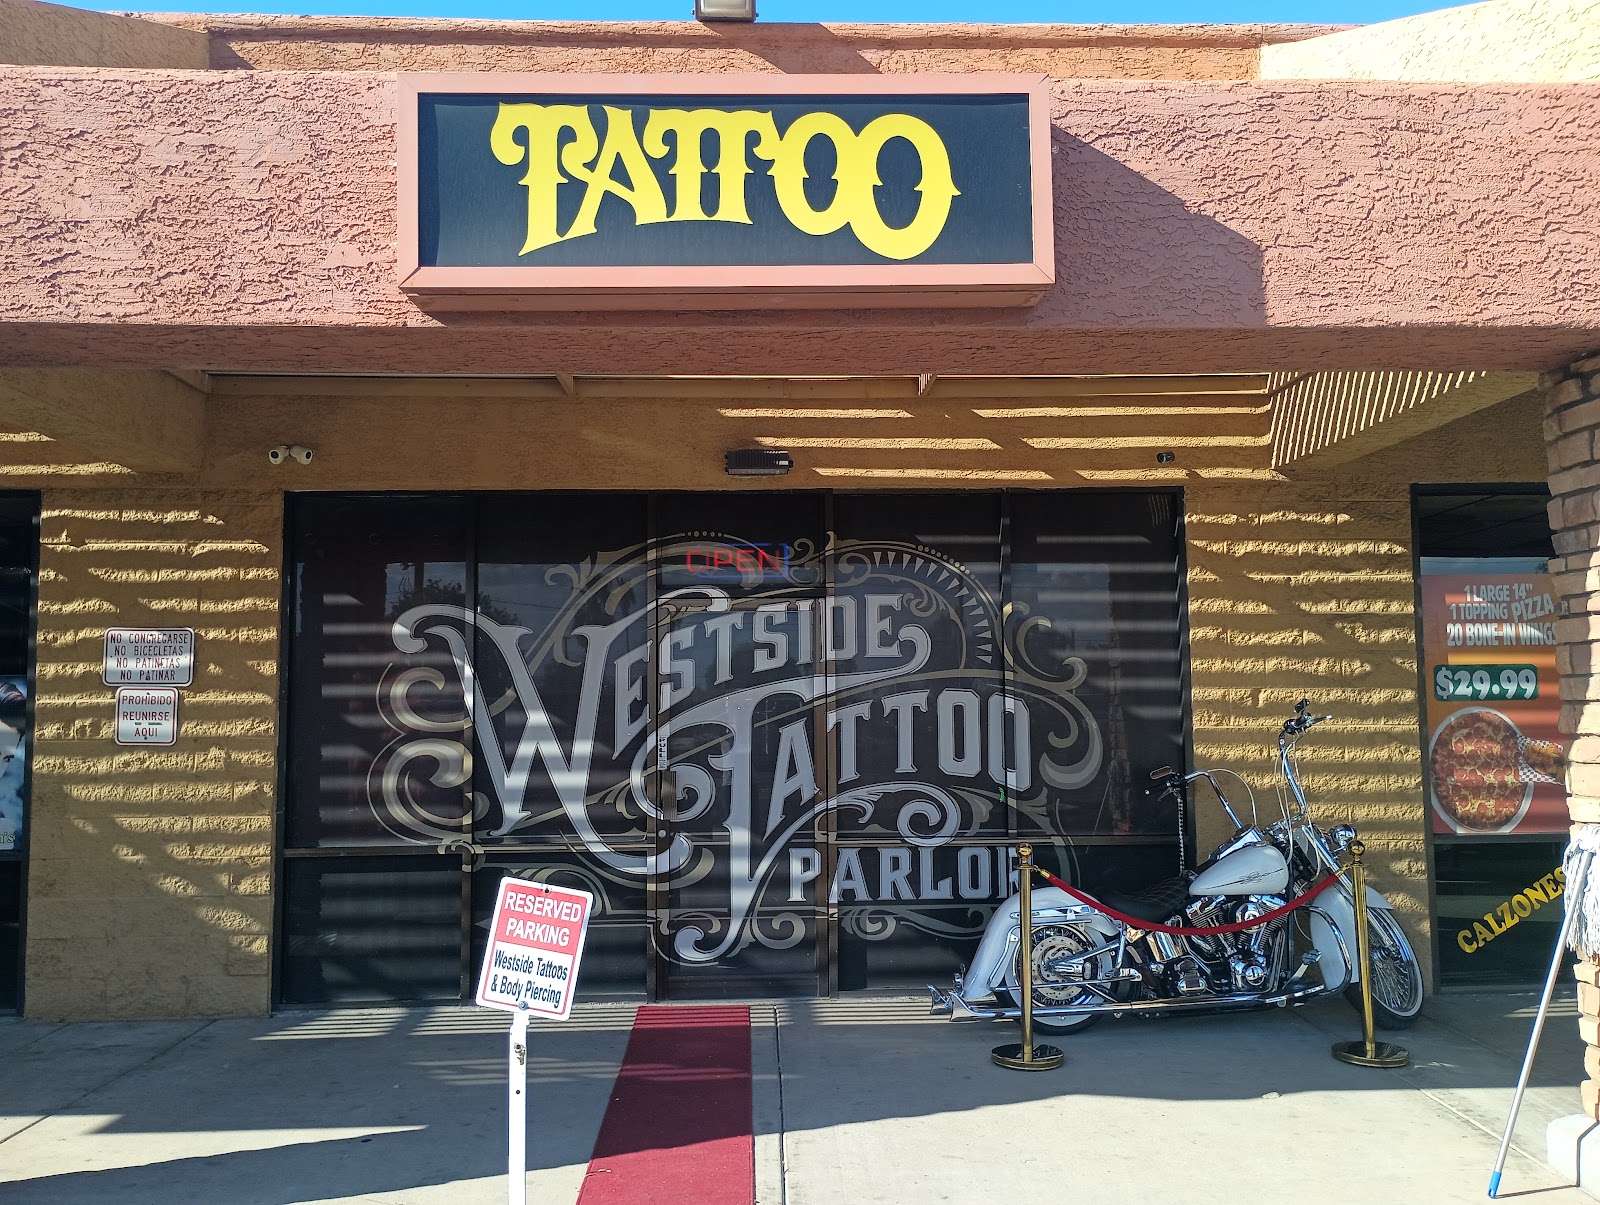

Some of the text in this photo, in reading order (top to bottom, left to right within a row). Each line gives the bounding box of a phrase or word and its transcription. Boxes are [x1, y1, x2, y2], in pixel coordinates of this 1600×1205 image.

[490, 102, 962, 260] TATTOO
[686, 549, 781, 572] OPEN
[1473, 584, 1510, 602] LARGE
[1450, 594, 1554, 623] 1 TOPPING PIZZA
[110, 633, 189, 645] NO CONGREGARSE
[1446, 623, 1463, 647] 20
[1466, 623, 1517, 646] BONE-IN
[114, 645, 184, 657] NO BICECLETAS
[116, 657, 181, 669] NO PATINETAS
[120, 669, 176, 681] NO PATINAR
[1435, 667, 1537, 700] $29.99
[121, 695, 173, 706] PROHIBIDO
[122, 711, 170, 722] REUNIRSE
[134, 727, 159, 738] AQUI
[392, 586, 905, 875] WESTSIDE
[504, 891, 582, 923] RESERVED
[505, 917, 570, 947] PARKING
[493, 949, 568, 981] Westside Tattoos
[490, 974, 562, 1009] & Body Piercing
